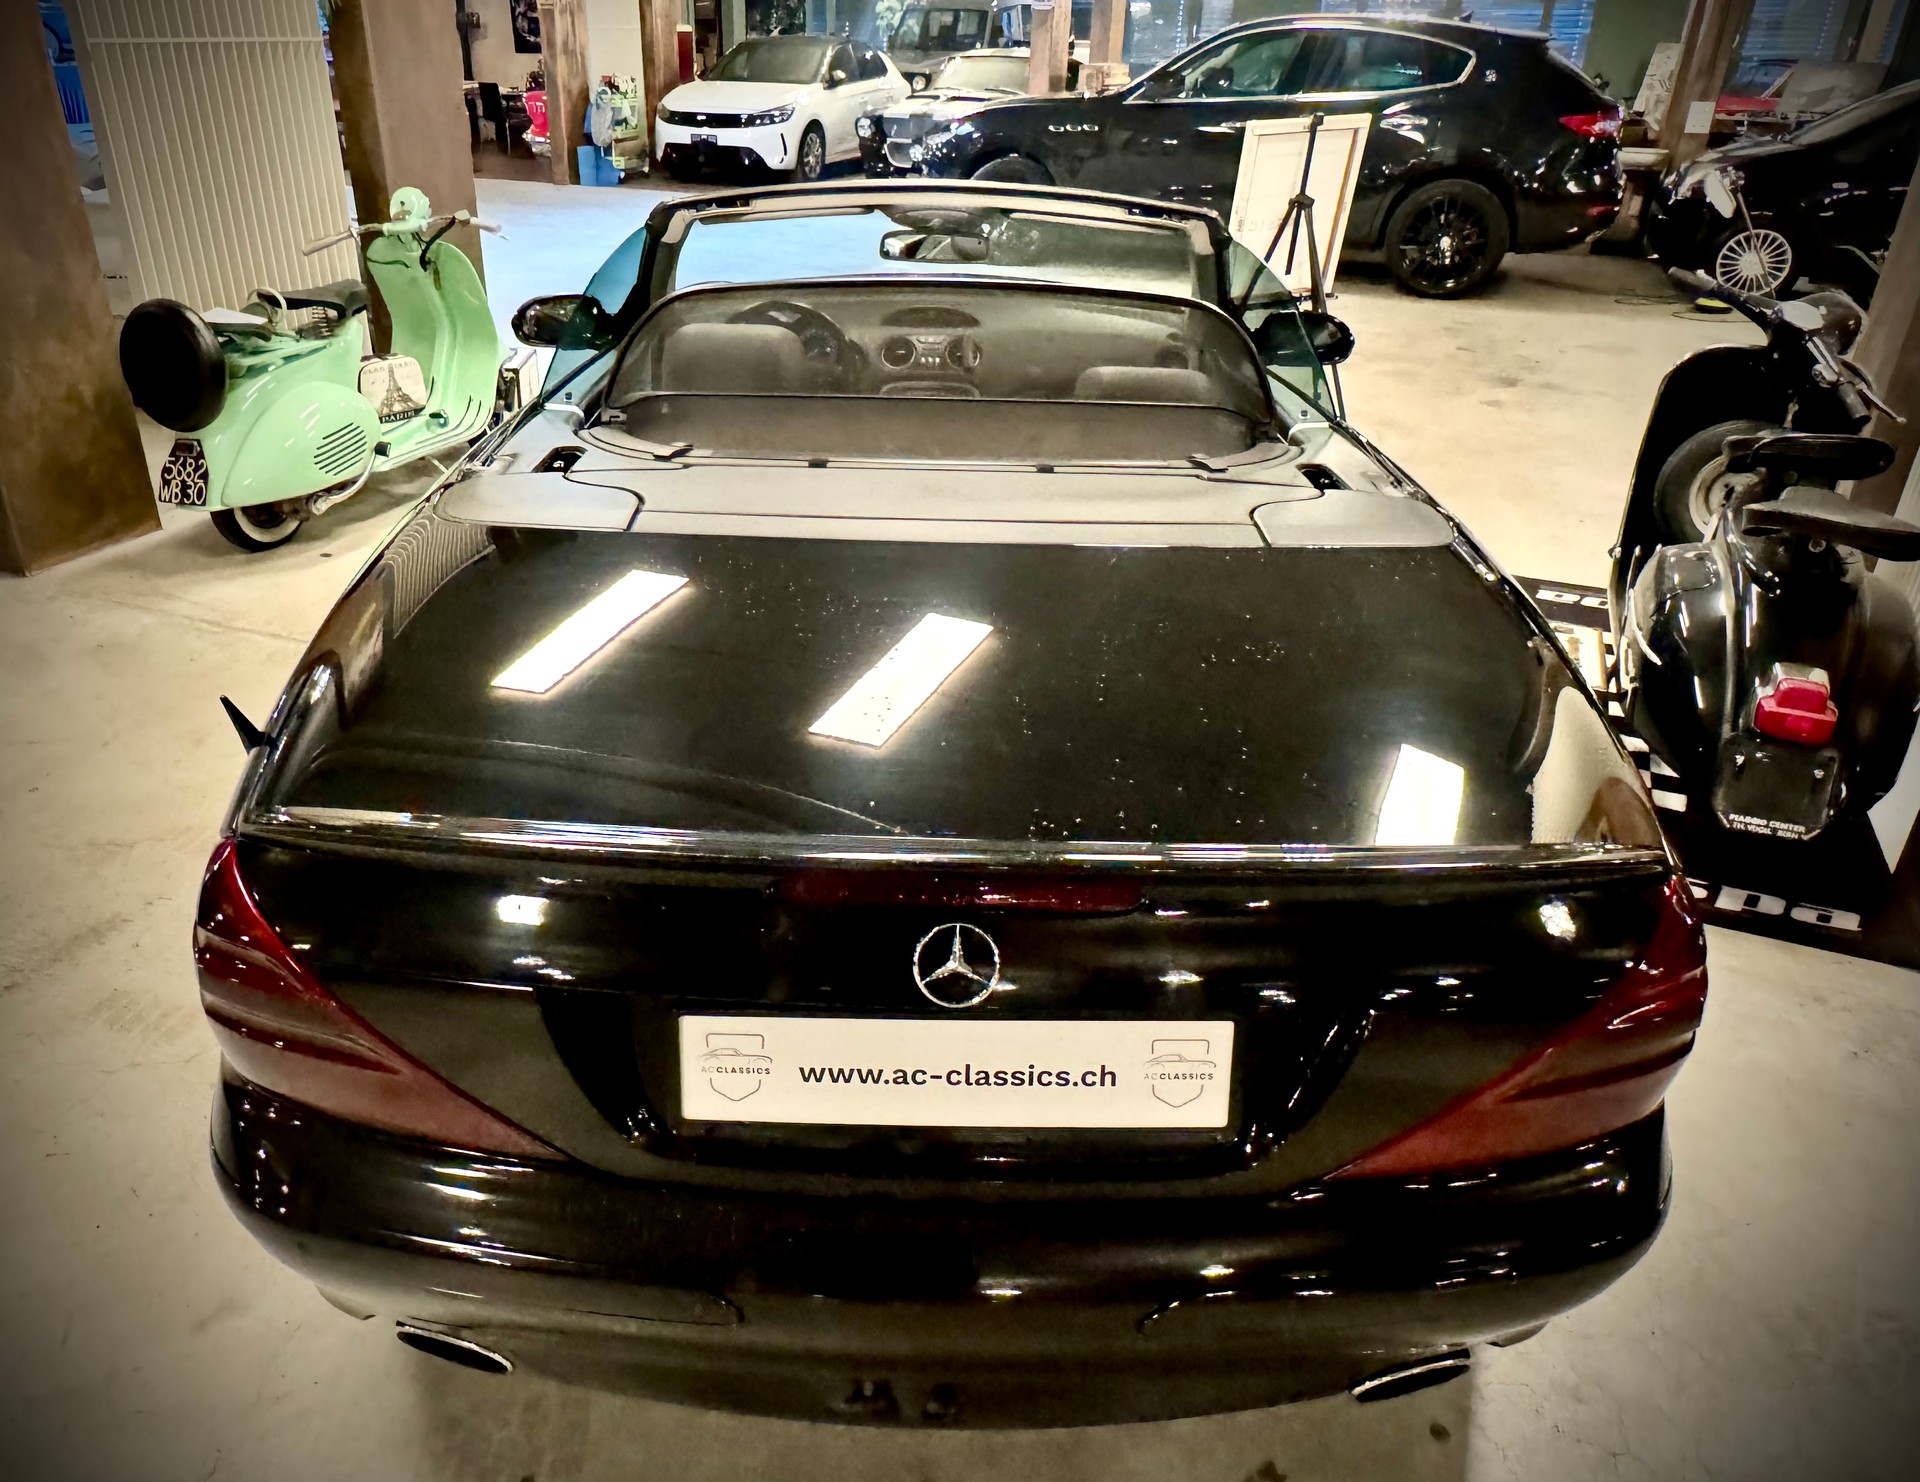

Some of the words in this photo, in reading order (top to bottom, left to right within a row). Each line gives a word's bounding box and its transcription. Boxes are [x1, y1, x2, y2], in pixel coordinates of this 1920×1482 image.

[164, 456, 207, 482] 5682
[184, 481, 206, 504] 30
[1729, 813, 1768, 827] PIAGGIO
[1769, 820, 1806, 834] CENTER
[798, 1063, 1118, 1088] www.ac-classics.ch
